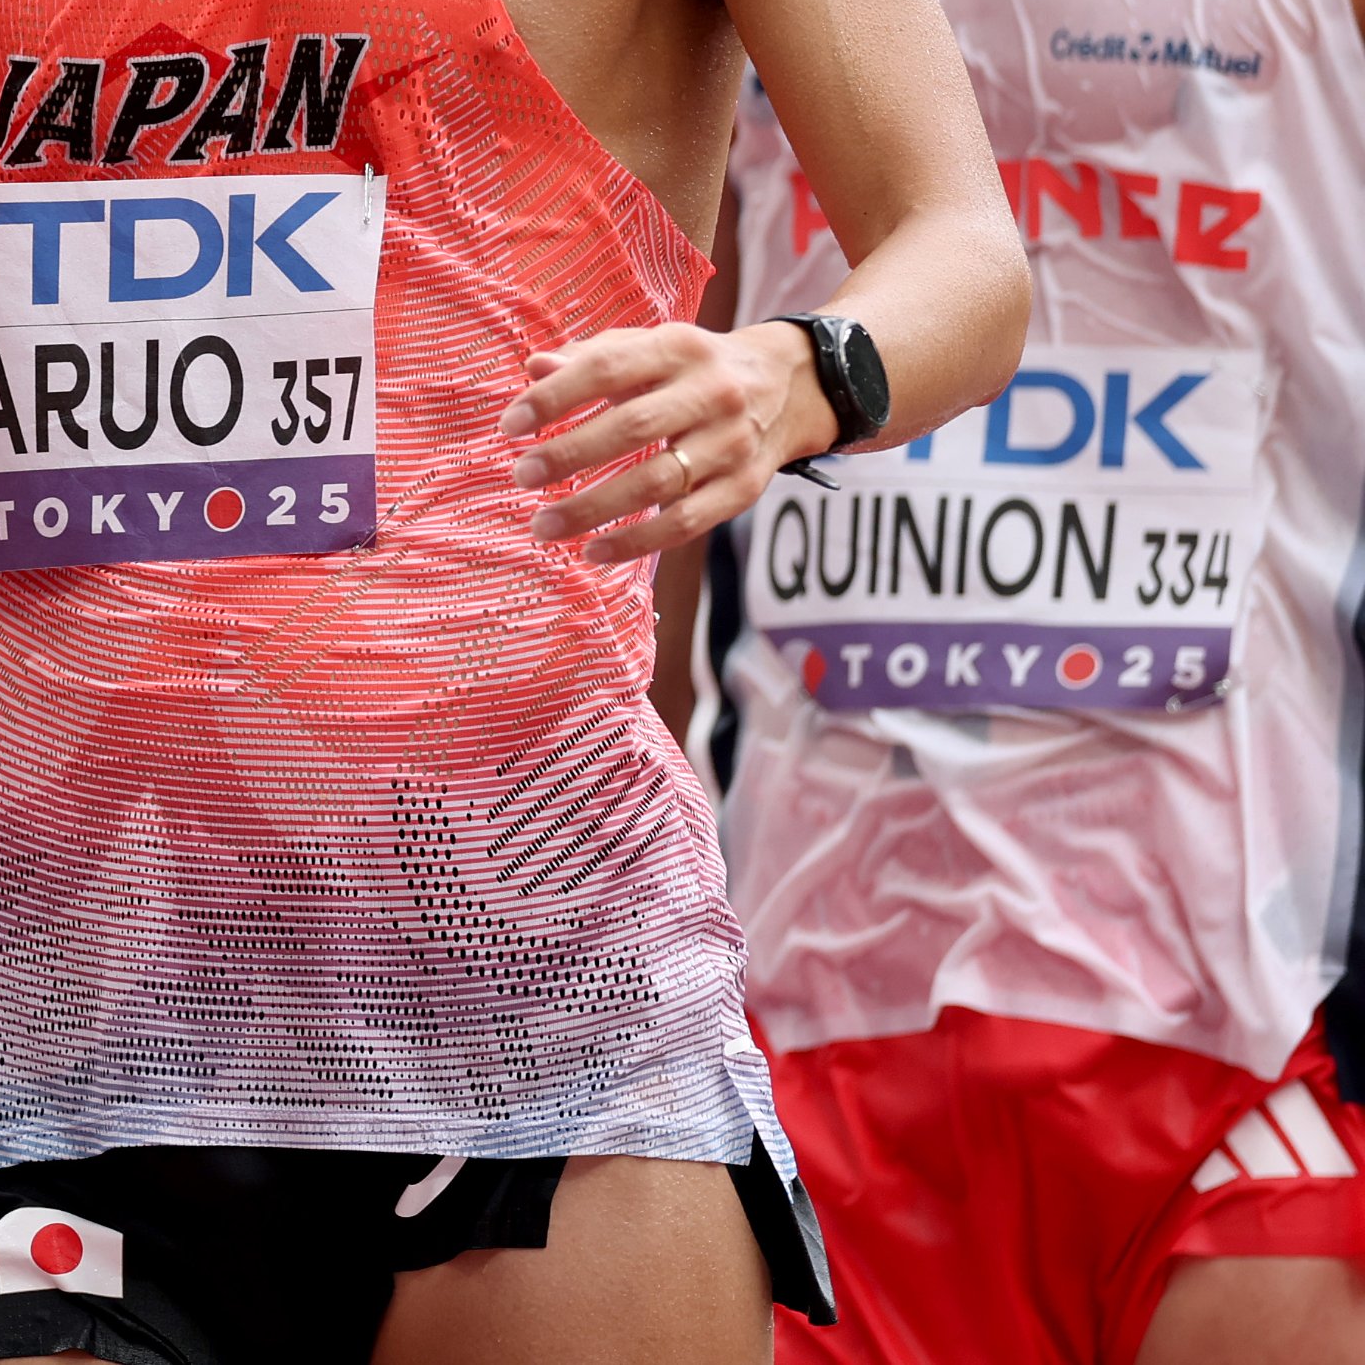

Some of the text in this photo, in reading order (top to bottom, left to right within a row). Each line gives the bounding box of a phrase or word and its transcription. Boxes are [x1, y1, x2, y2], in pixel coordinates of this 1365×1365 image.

[270, 356, 363, 447] 357
[908, 370, 1214, 472] DK
[267, 483, 351, 526] 25
[770, 493, 1232, 609] QUINION 334
[840, 642, 1206, 691] TOKYO 25
